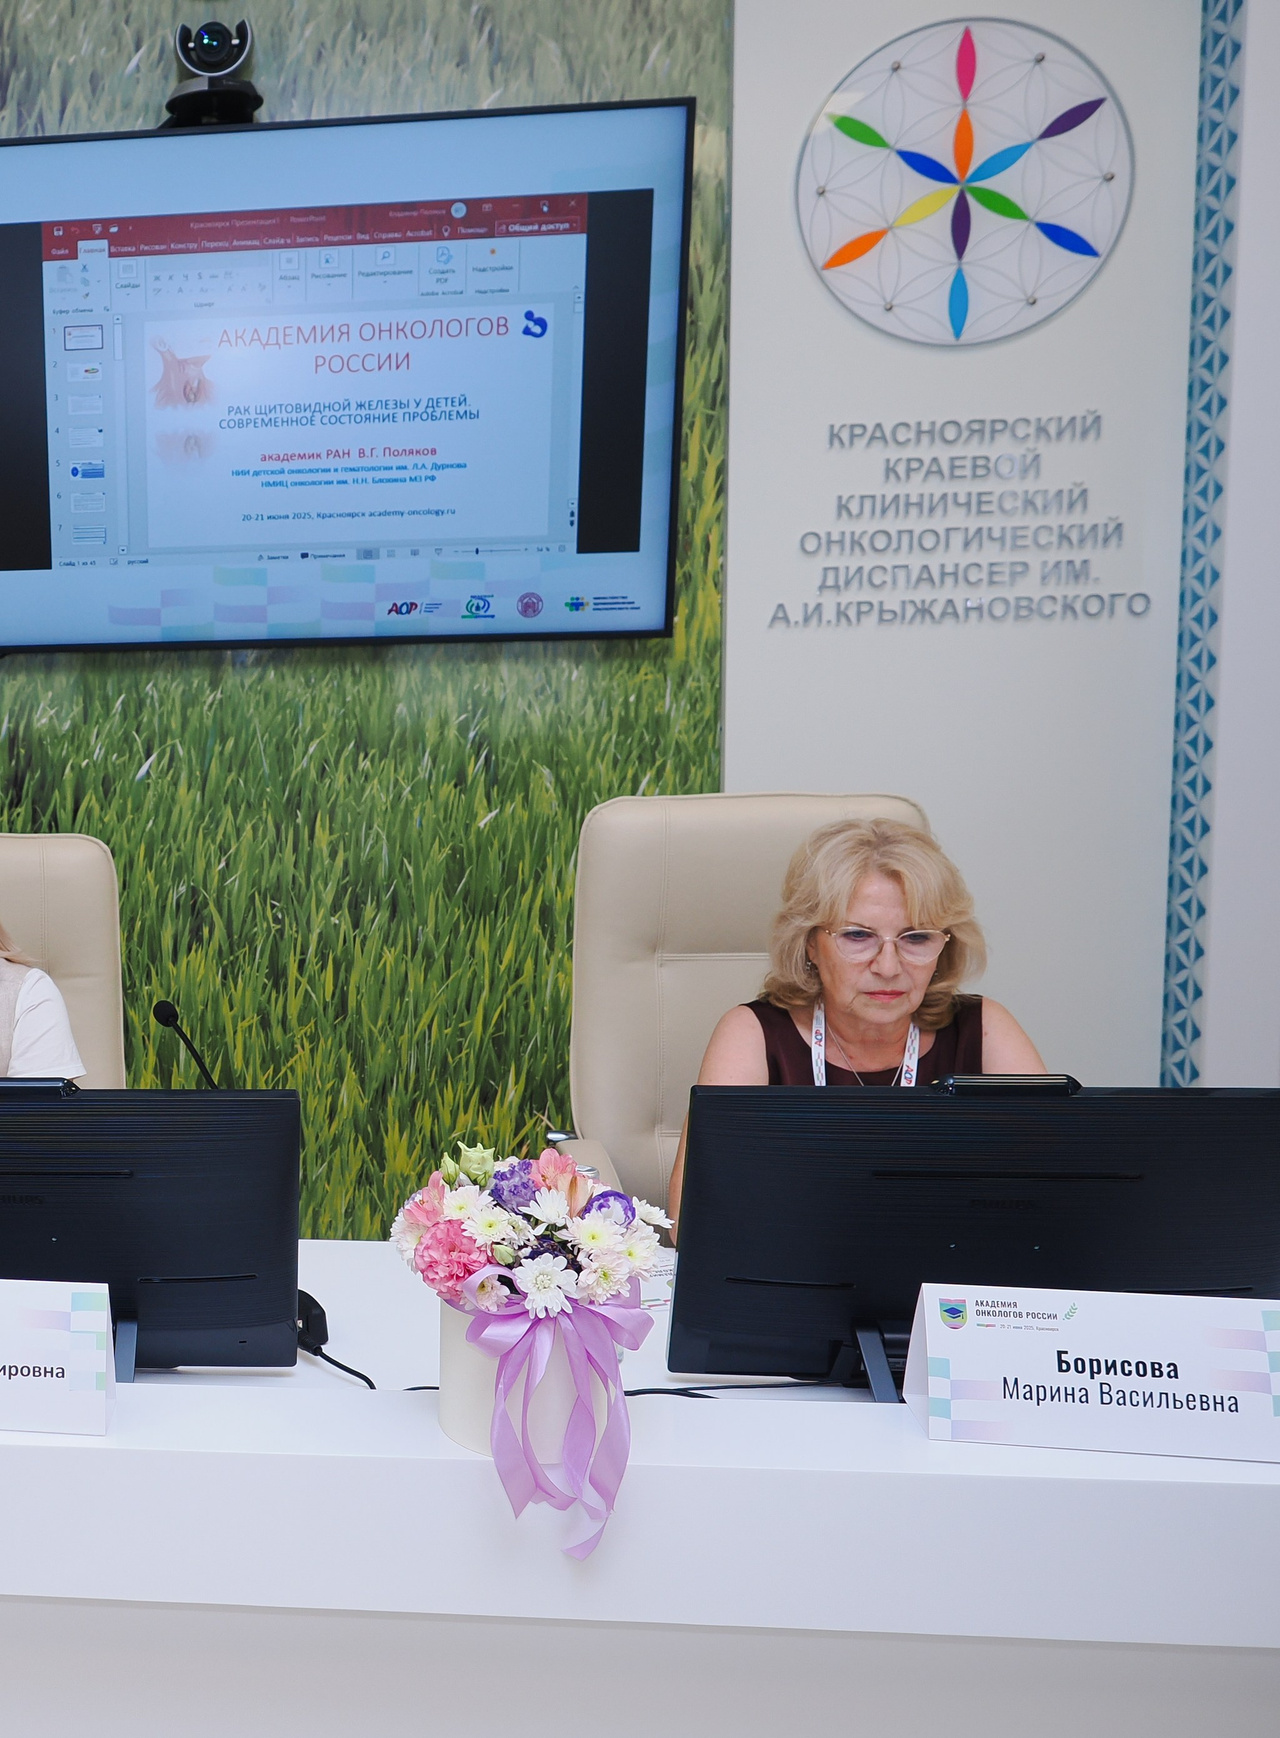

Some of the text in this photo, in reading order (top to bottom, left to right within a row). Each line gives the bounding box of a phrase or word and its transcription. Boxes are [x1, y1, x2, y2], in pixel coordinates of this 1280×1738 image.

[508, 222, 570, 232] Общий доступ
[110, 245, 136, 253] Вставка
[218, 316, 509, 351] АКАДЕМИЯ ОНКОЛОГОВ
[314, 352, 411, 375] РОССИИ
[227, 405, 250, 416] РАК
[255, 400, 351, 417] ЩИТОВИДНОЙ
[355, 400, 410, 411] ЖЕЛЕЗЫ
[413, 399, 422, 408] У
[219, 409, 480, 430] СОВРЕМЕННОЕ СОСТОЯНИЕ ПРОБЛЕМЫ
[827, 410, 1103, 450] КРАСНОЯРСКИЙ
[260, 447, 437, 463] академик РАН В.Г. Поляков
[883, 448, 1042, 484] КРАЕВОЙ
[231, 469, 250, 477] НИИ
[252, 468, 285, 477] детской
[287, 466, 331, 475] онкологии
[341, 463, 394, 473] гематологии
[395, 464, 409, 472] им.
[430, 461, 467, 471] Дурнова
[261, 480, 288, 489] НМИЦ
[290, 478, 333, 486] онкологии
[424, 474, 436, 482] РФ
[835, 483, 1089, 521] КЛИНИЧЕСКИЙ
[267, 513, 289, 521] июня
[291, 512, 314, 521] 2025,
[316, 509, 366, 521] Красноярск
[799, 517, 1124, 557] ОНКОЛОГИЧЕСКИЙ
[816, 559, 1101, 595] ДИСПАНСЕР ИМ.
[768, 593, 1152, 628] А.И.КРЫЖАНОВСКОГО
[975, 1300, 1017, 1308] АКАДЕМИЯ
[975, 1309, 1058, 1320] ОНКОЛОГОВ РОССИИ
[1056, 1350, 1180, 1380] Борисова
[1002, 1377, 1240, 1413] Марина Васильевна
